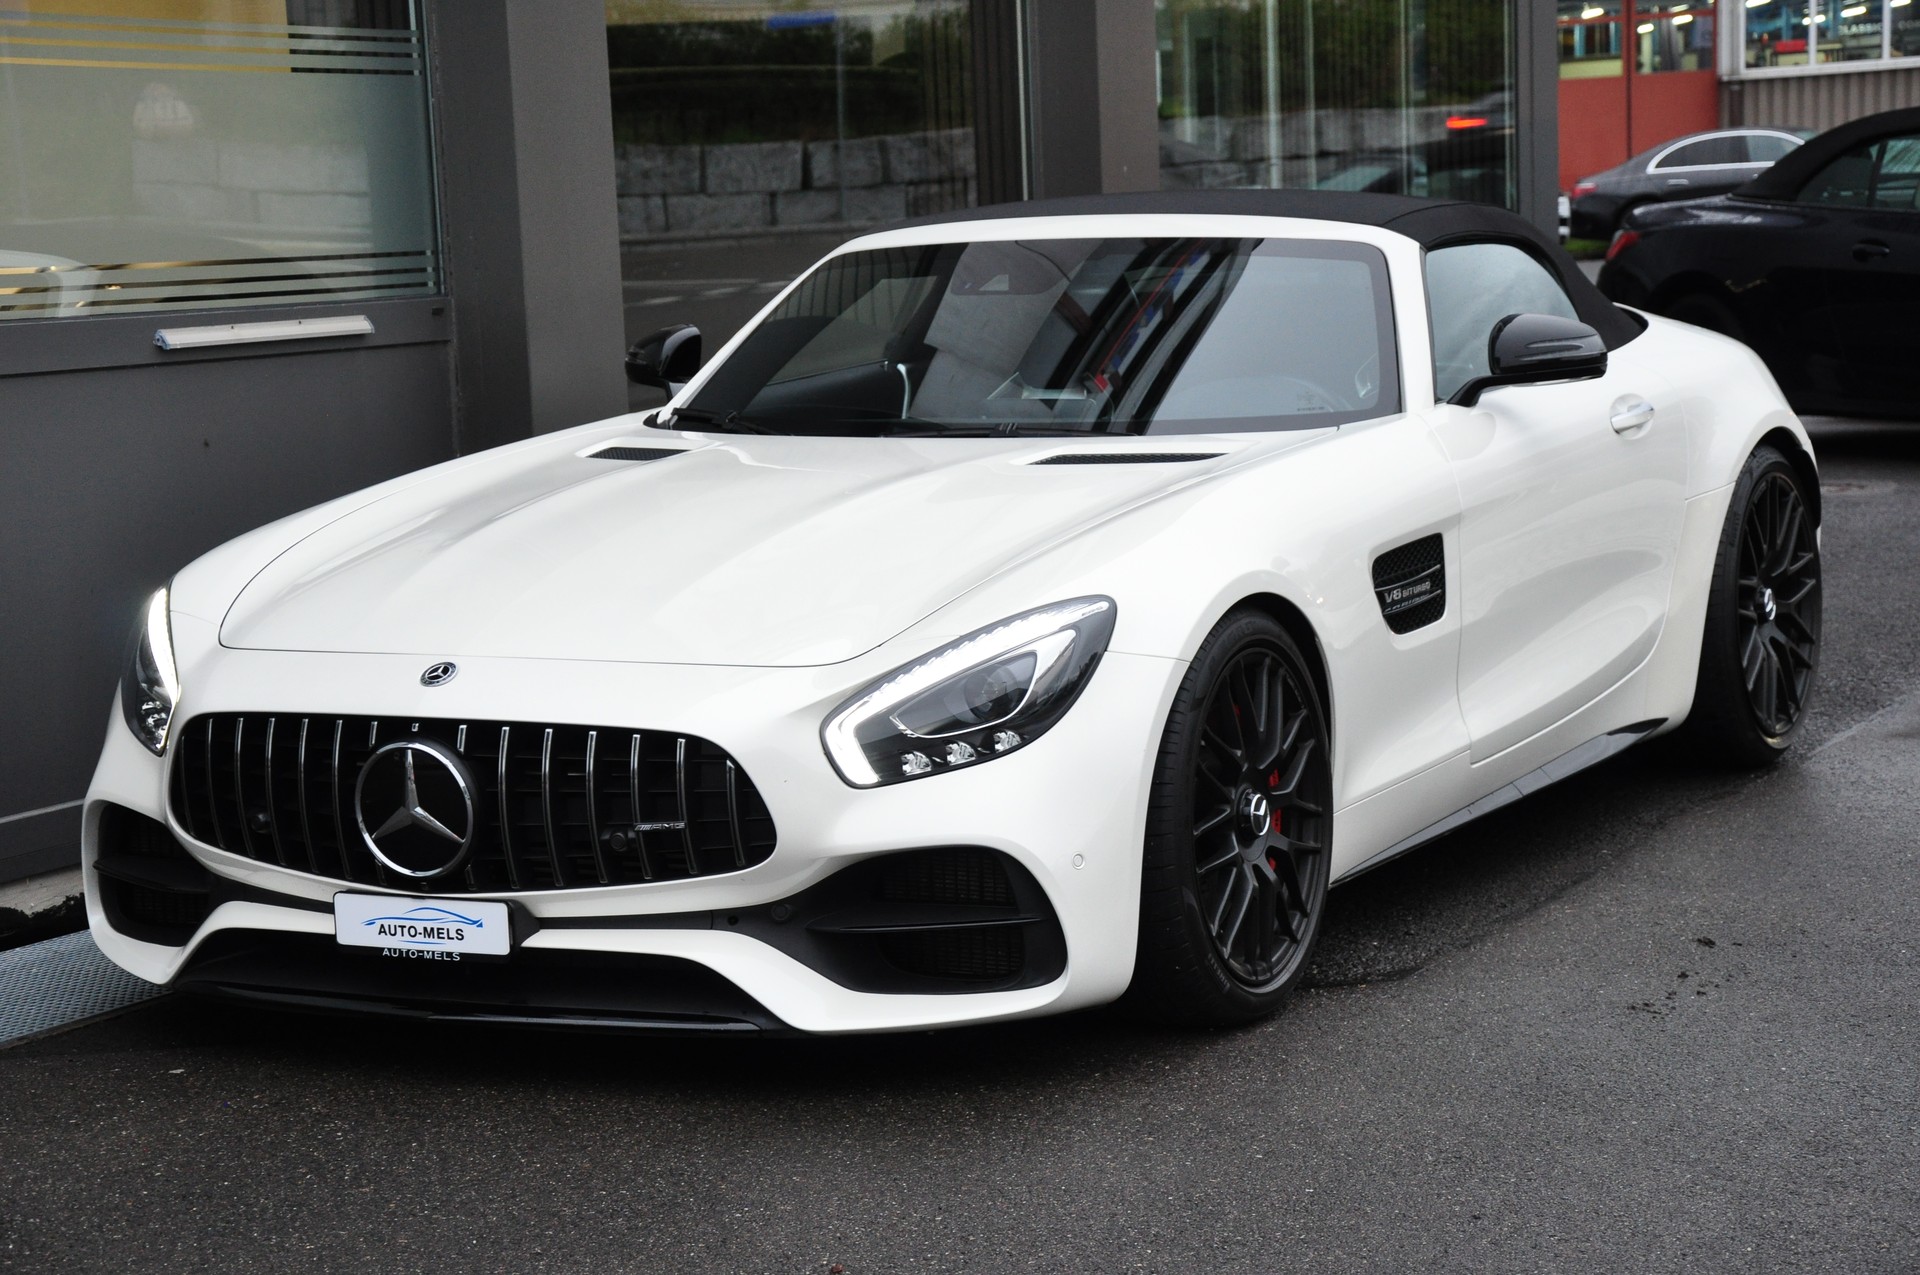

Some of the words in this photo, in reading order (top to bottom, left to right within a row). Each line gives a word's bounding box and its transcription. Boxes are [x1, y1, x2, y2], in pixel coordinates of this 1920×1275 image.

[1384, 588, 1402, 603] V8
[1402, 581, 1431, 597] BITURBO
[651, 822, 685, 830] AMG
[378, 923, 465, 941] AUTO-MELS
[382, 948, 461, 961] AUTO-MELS
